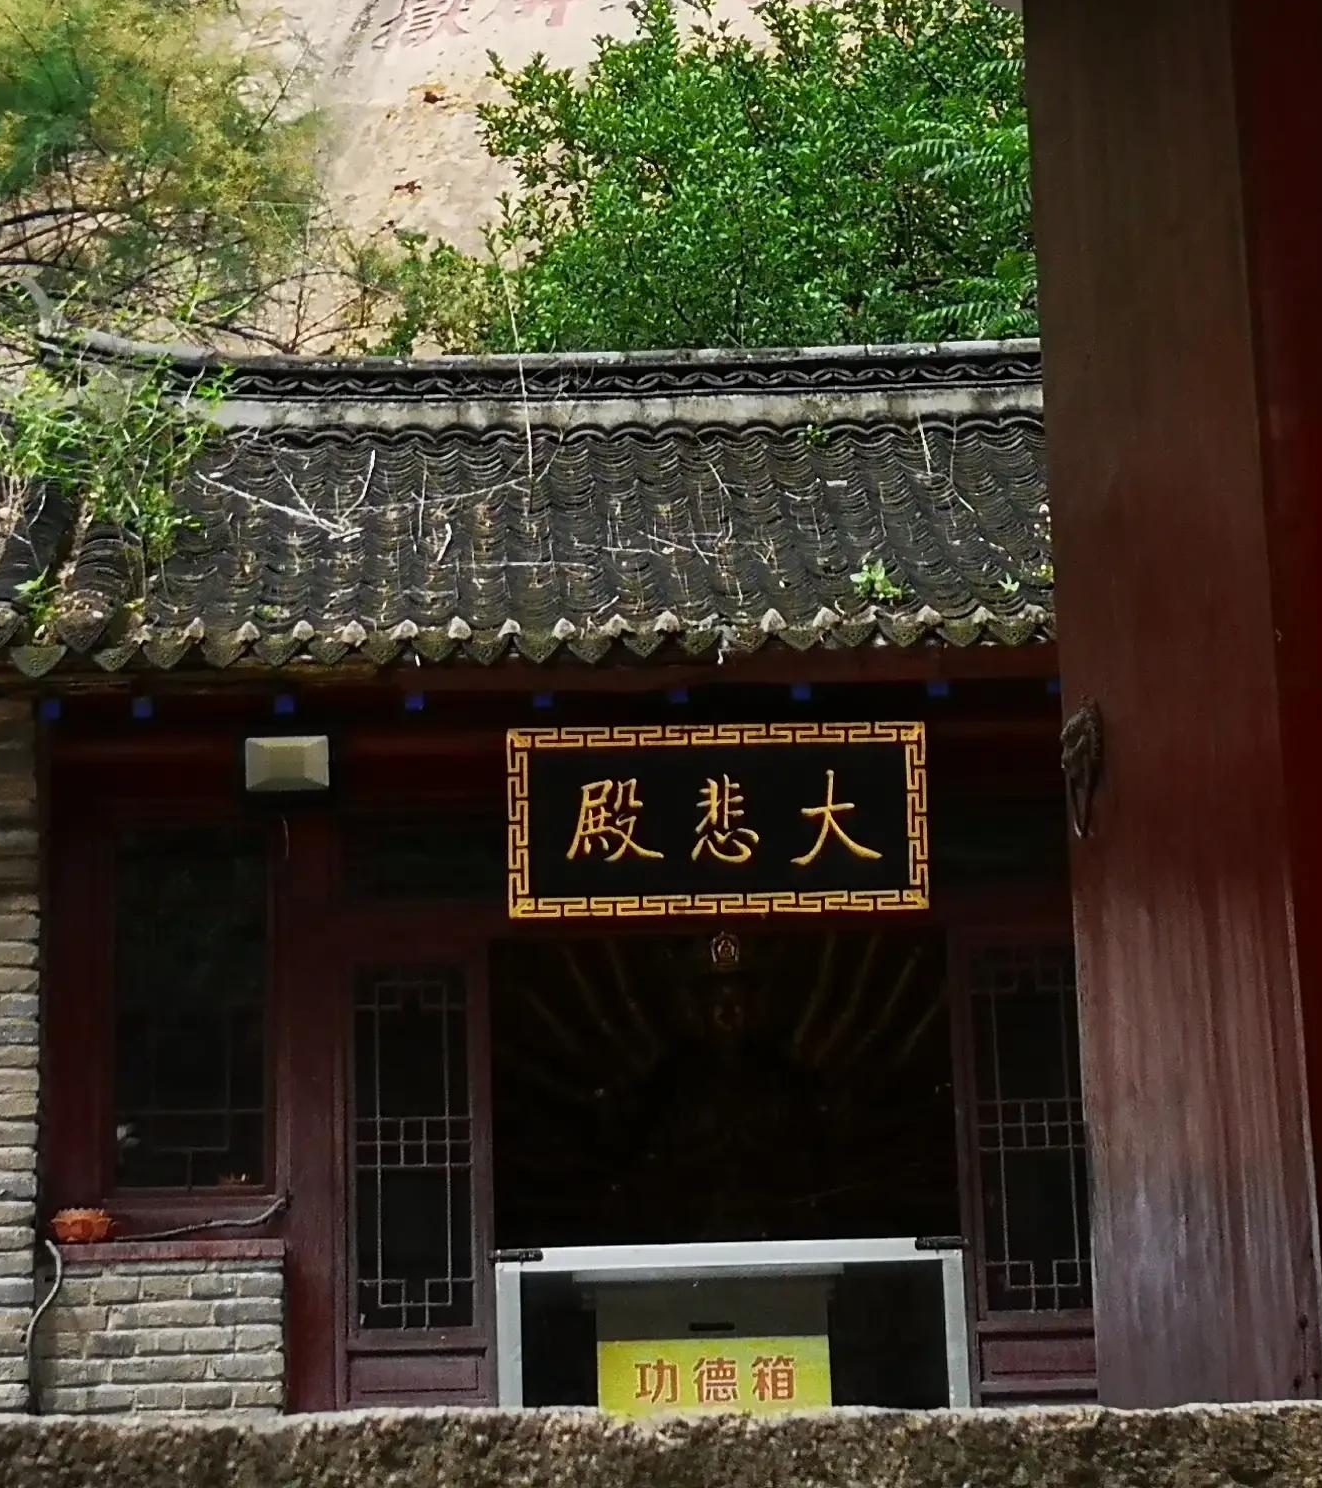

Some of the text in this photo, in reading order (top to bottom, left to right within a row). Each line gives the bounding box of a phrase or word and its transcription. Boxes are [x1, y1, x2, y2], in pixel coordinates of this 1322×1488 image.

[565, 768, 884, 867] 大悲殿
[633, 1354, 798, 1404] 功德箱
